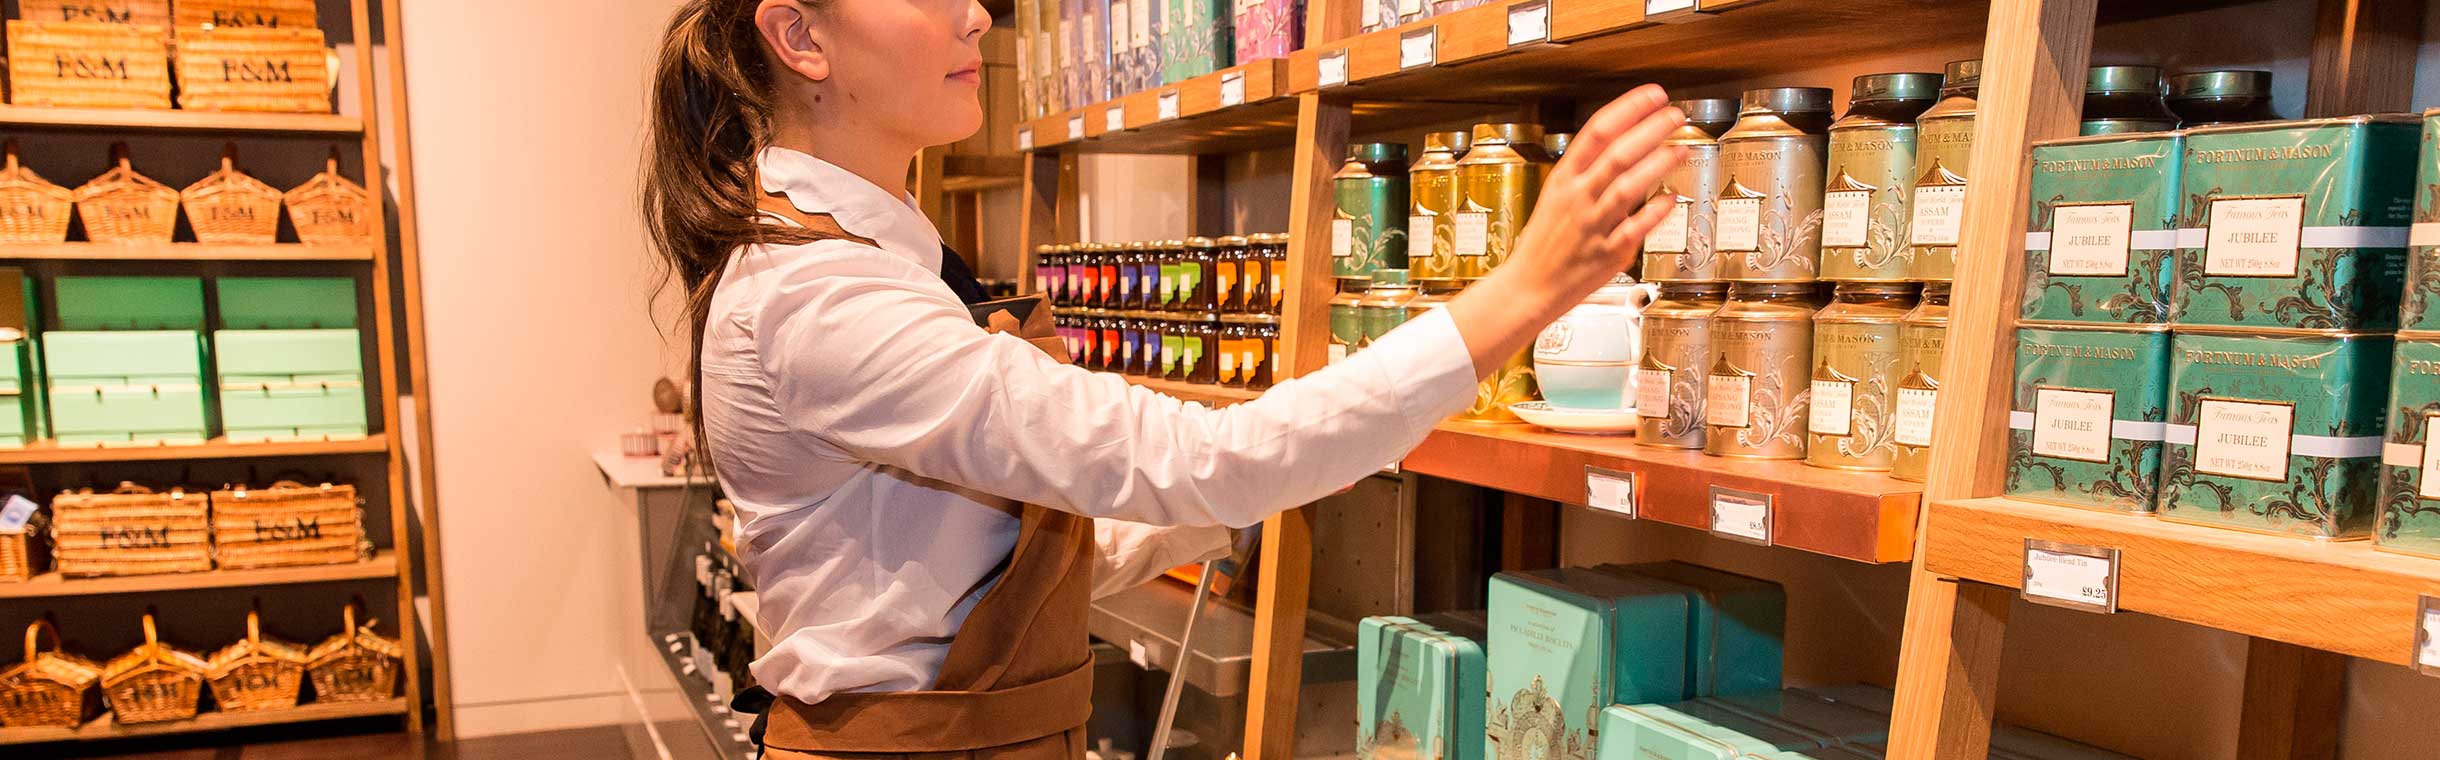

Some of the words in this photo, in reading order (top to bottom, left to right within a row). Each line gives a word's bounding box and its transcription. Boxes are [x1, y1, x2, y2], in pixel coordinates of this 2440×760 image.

[56, 55, 128, 79] F&M
[222, 58, 292, 83] F&M
[1855, 140, 1894, 151] MASON
[1744, 150, 1782, 160] MASON
[2197, 148, 2266, 164] FORTNUM
[2268, 147, 2278, 160] &
[2280, 145, 2332, 160] MASON
[1681, 158, 1709, 168] ASON
[2041, 159, 2100, 173] FORTNUM
[2102, 159, 2110, 171] &
[2112, 157, 2155, 170] MASON
[2224, 205, 2262, 219] Famous
[2266, 205, 2288, 219] Teas
[2068, 235, 2111, 246] JUBILEE
[2228, 232, 2278, 244] JUBILEE
[1736, 331, 1772, 340] MASON
[1839, 333, 1875, 344] MASON
[2024, 343, 2082, 358] FORTNUM
[2084, 346, 2091, 358] &
[2094, 346, 2136, 360] MASON
[2185, 350, 2255, 366] FORTNUM
[2257, 353, 2266, 367] &
[2270, 353, 2321, 369] MASON
[2213, 406, 2252, 422] Famous
[2254, 410, 2279, 425] Teas
[2051, 418, 2093, 432] JUBILEE
[2217, 432, 2269, 448] JUBILEE
[2081, 586, 2106, 599] £9.25
